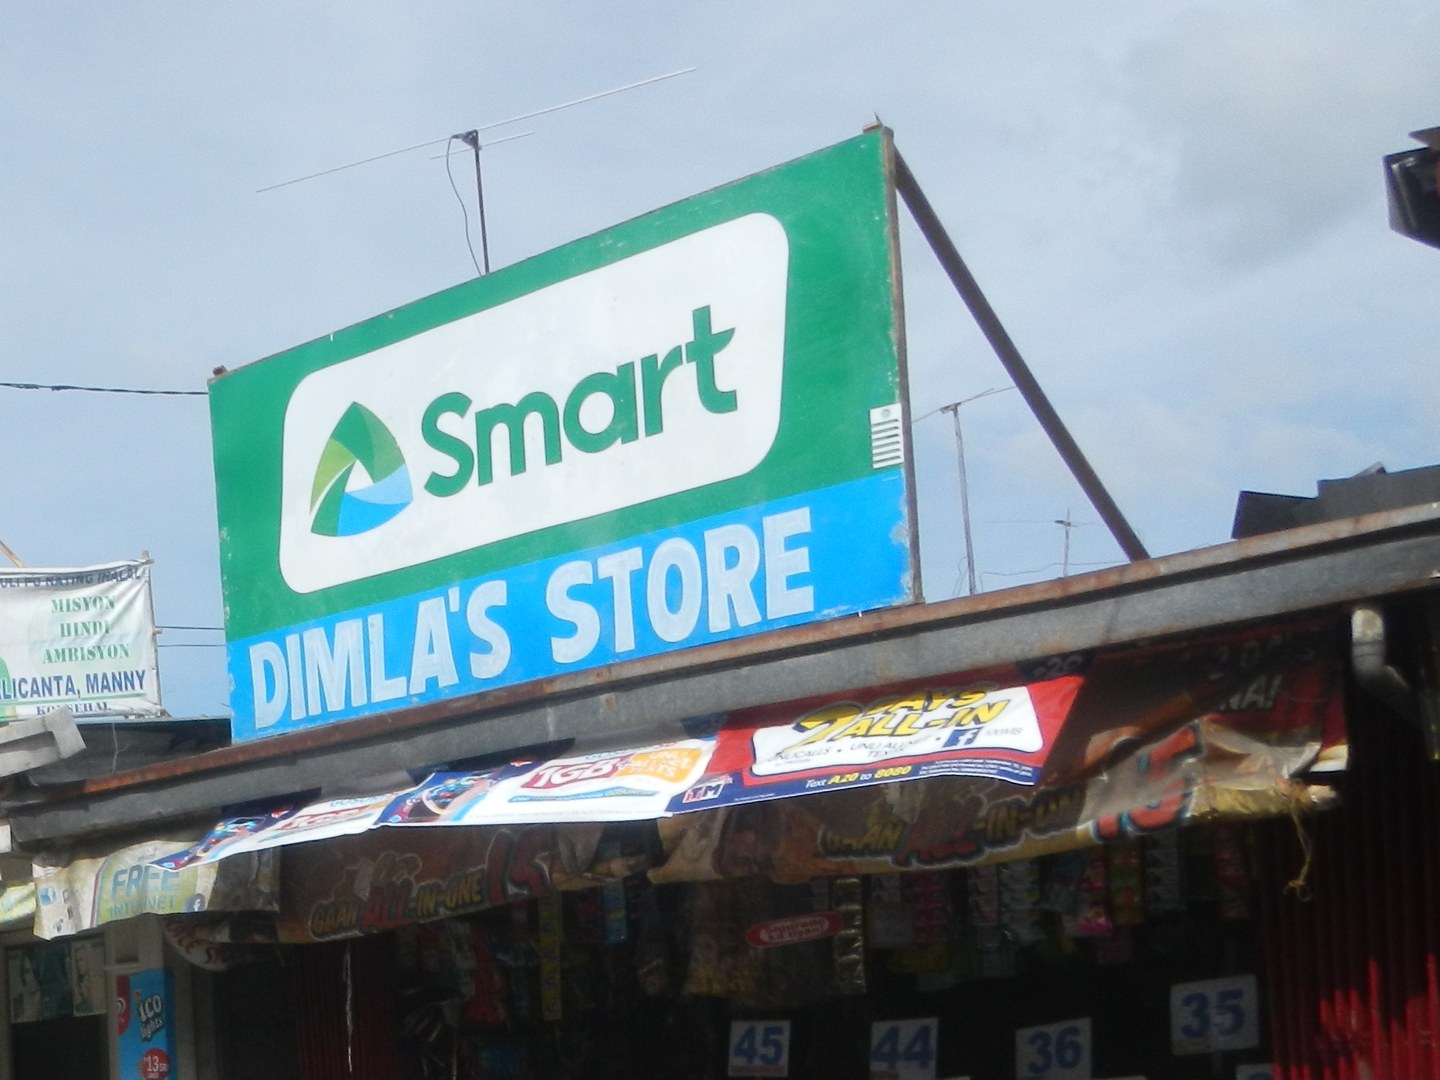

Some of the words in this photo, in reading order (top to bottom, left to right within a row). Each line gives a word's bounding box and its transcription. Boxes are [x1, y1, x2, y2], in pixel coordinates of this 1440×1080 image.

[419, 305, 738, 499] Smart
[50, 595, 116, 614] MISYON
[249, 578, 512, 730] DIMLA'S
[546, 505, 815, 666] STORE
[59, 619, 111, 638] HINDI
[42, 643, 130, 665] AMBISYON
[85, 669, 146, 694] MANNY
[838, 699, 1012, 741] ALL-IN
[532, 759, 616, 789] 1GB
[805, 778, 827, 790] Text
[827, 772, 859, 785] A20
[860, 772, 874, 781] to
[874, 765, 912, 779] 8080
[111, 864, 180, 898] FREE
[1180, 987, 1246, 1039] 35
[733, 1025, 784, 1066] 45
[871, 1025, 933, 1069] 44
[1027, 1026, 1082, 1075] 36
